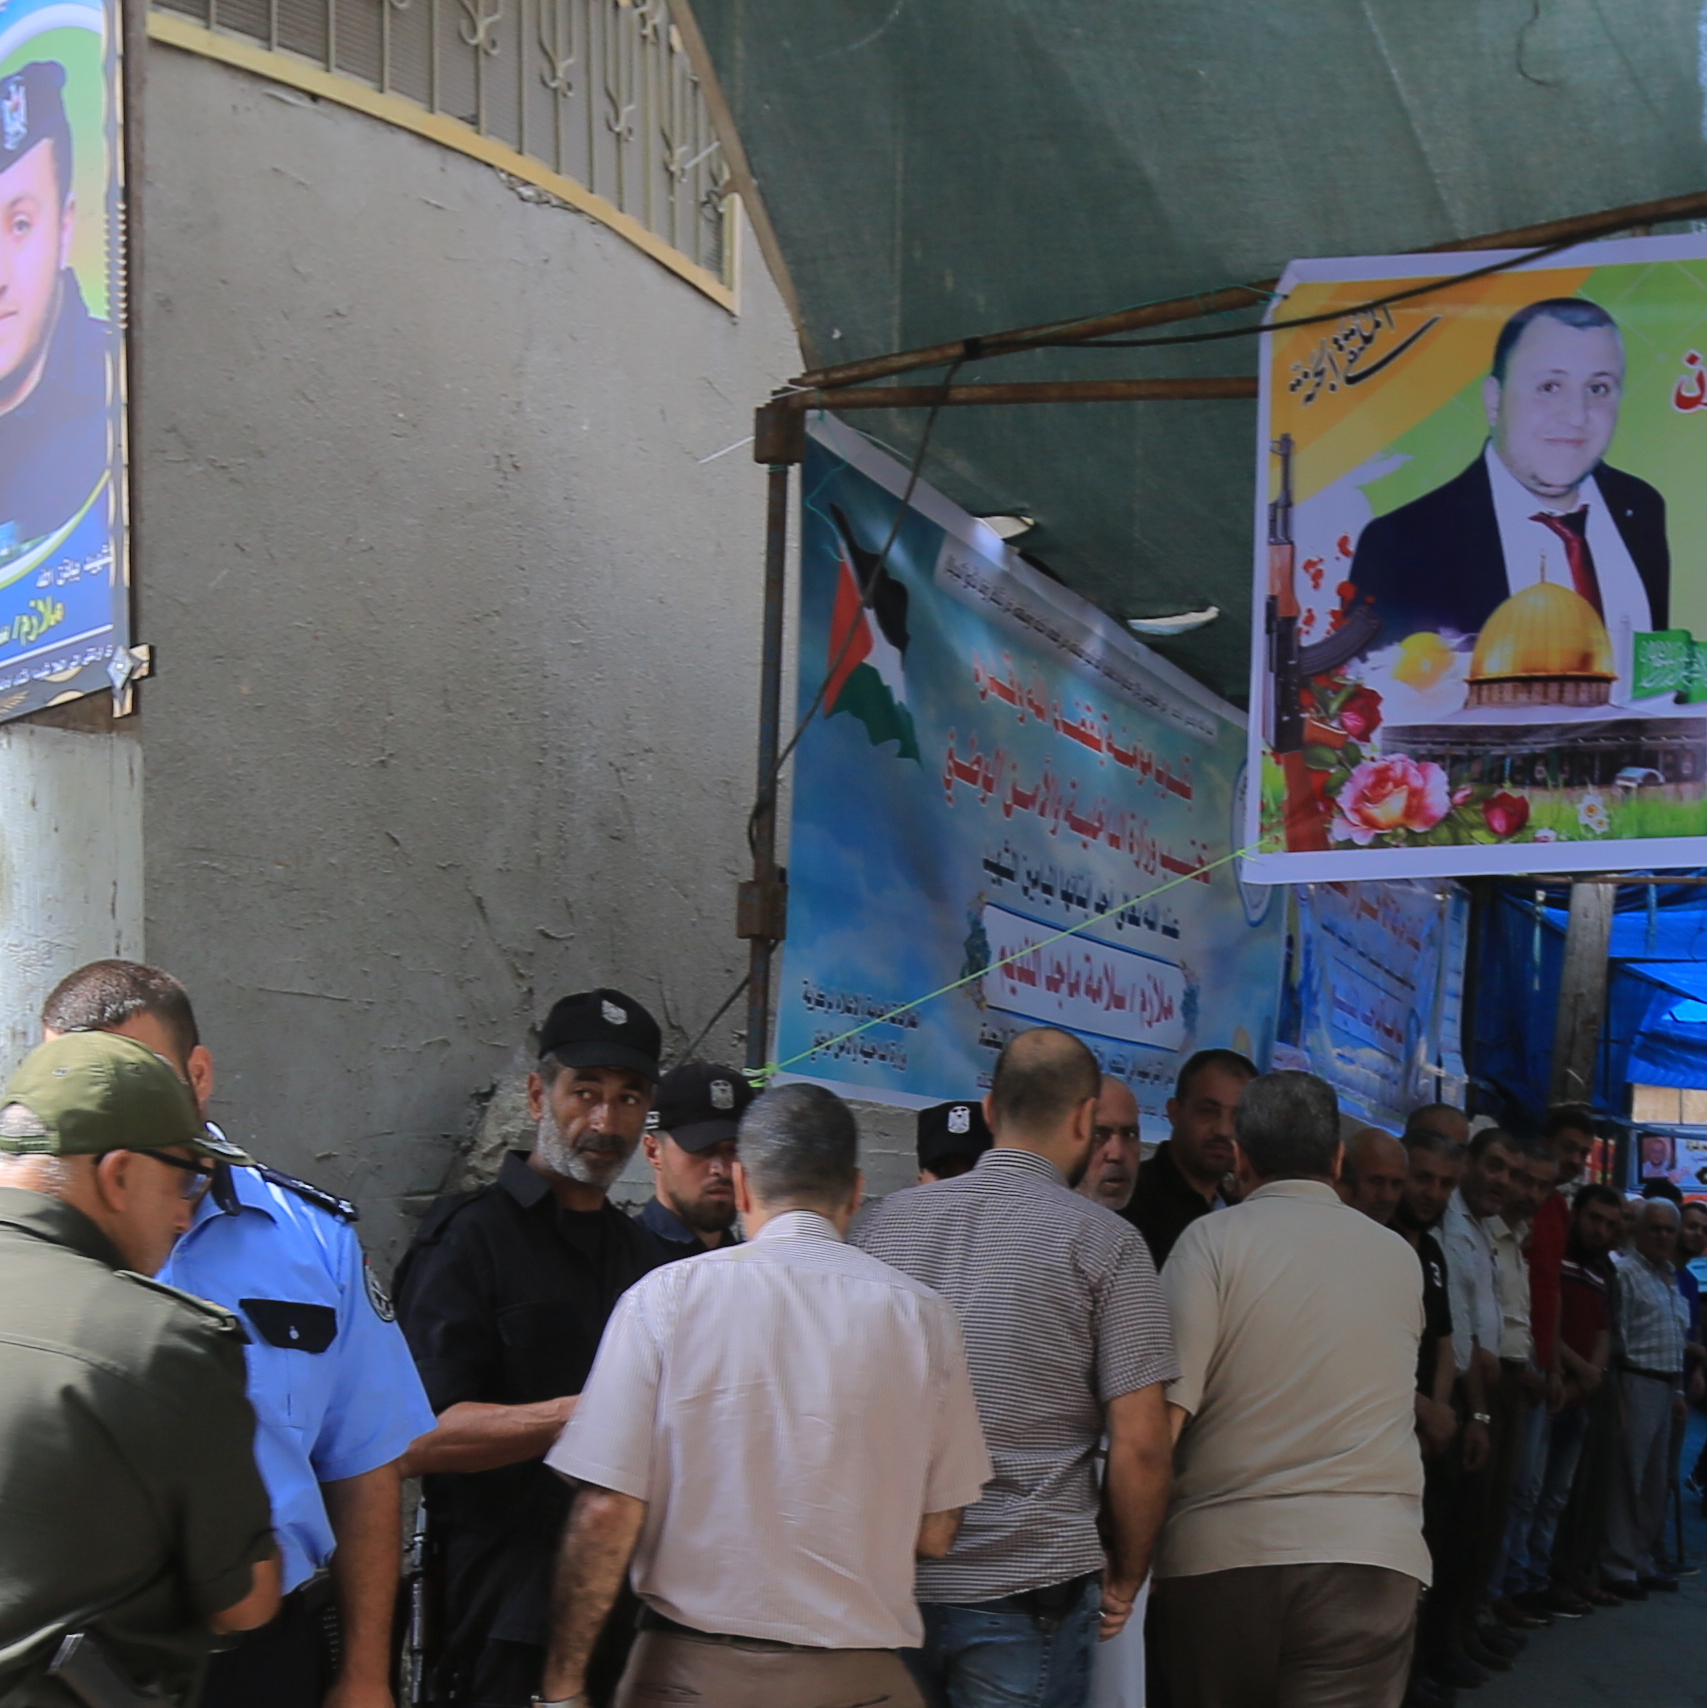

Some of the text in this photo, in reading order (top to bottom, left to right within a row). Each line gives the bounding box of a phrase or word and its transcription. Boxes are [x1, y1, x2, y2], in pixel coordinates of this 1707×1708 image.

[998, 935, 1043, 996] النديم
[1045, 950, 1083, 1011] ماجد
[1083, 952, 1127, 1012] سلامة
